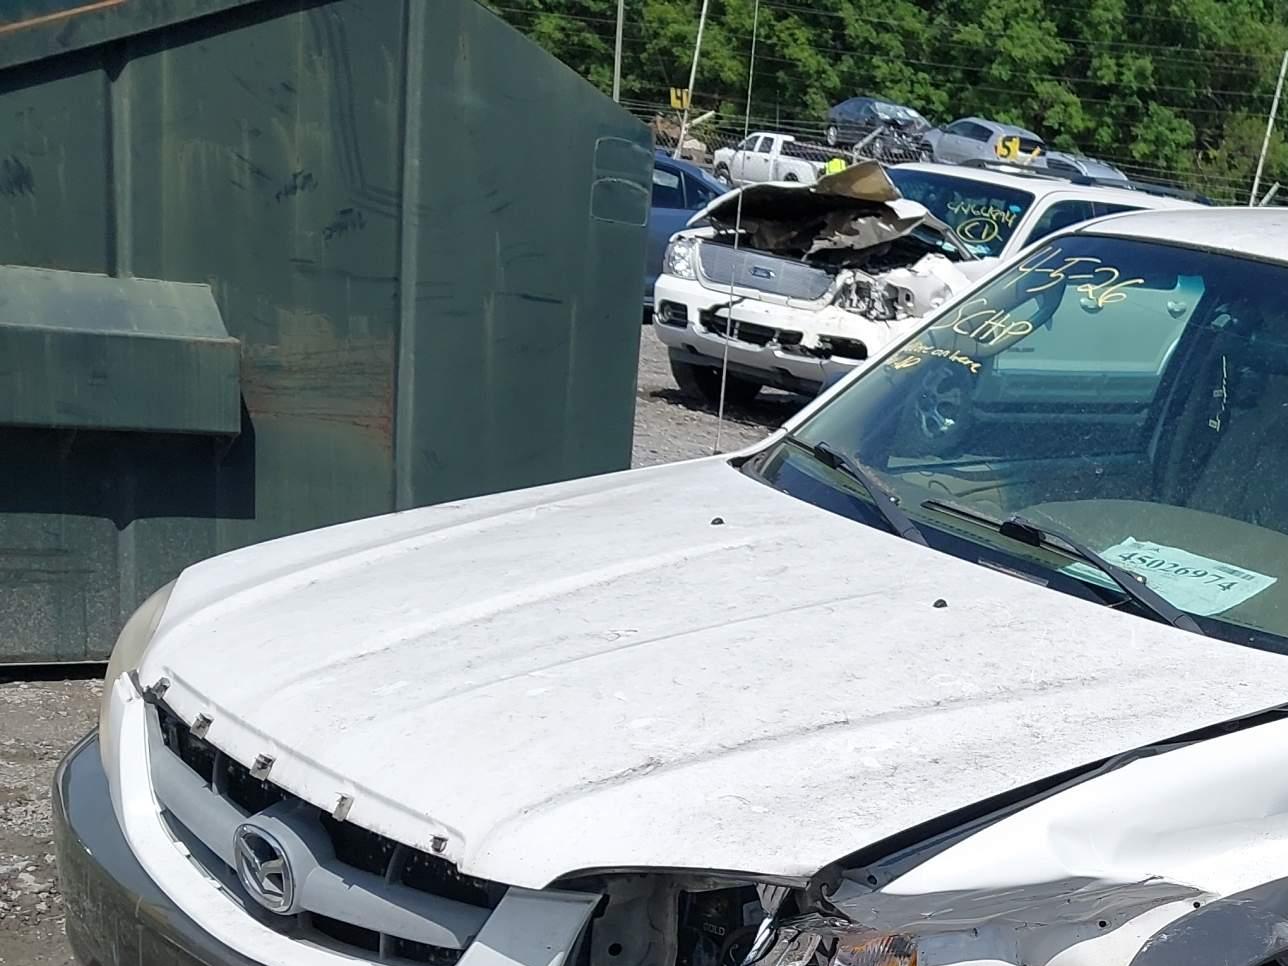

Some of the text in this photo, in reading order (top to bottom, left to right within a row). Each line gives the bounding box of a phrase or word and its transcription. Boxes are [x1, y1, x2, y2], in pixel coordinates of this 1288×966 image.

[1000, 135, 1015, 159] 5
[1003, 246, 1145, 308] 4-5-26
[1117, 551, 1240, 592] 45026974
